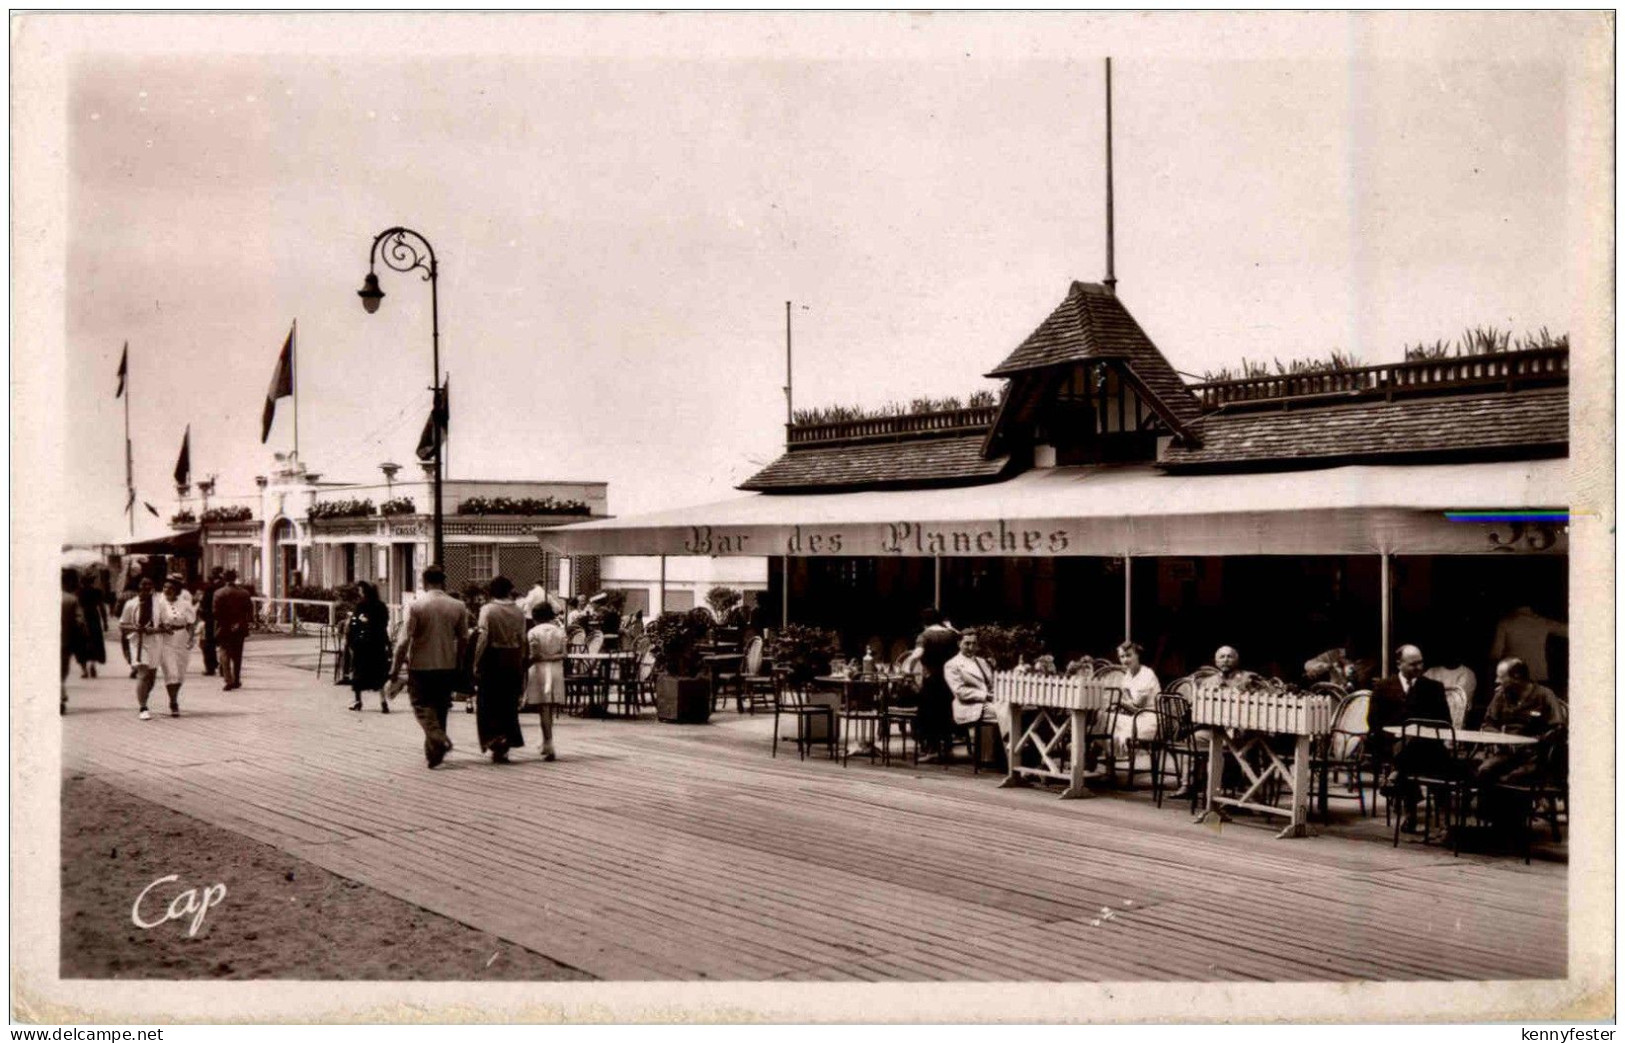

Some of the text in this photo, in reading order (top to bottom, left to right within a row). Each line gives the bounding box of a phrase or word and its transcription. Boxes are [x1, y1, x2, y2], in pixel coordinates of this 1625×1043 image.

[685, 519, 1069, 554] Bar des Planches
